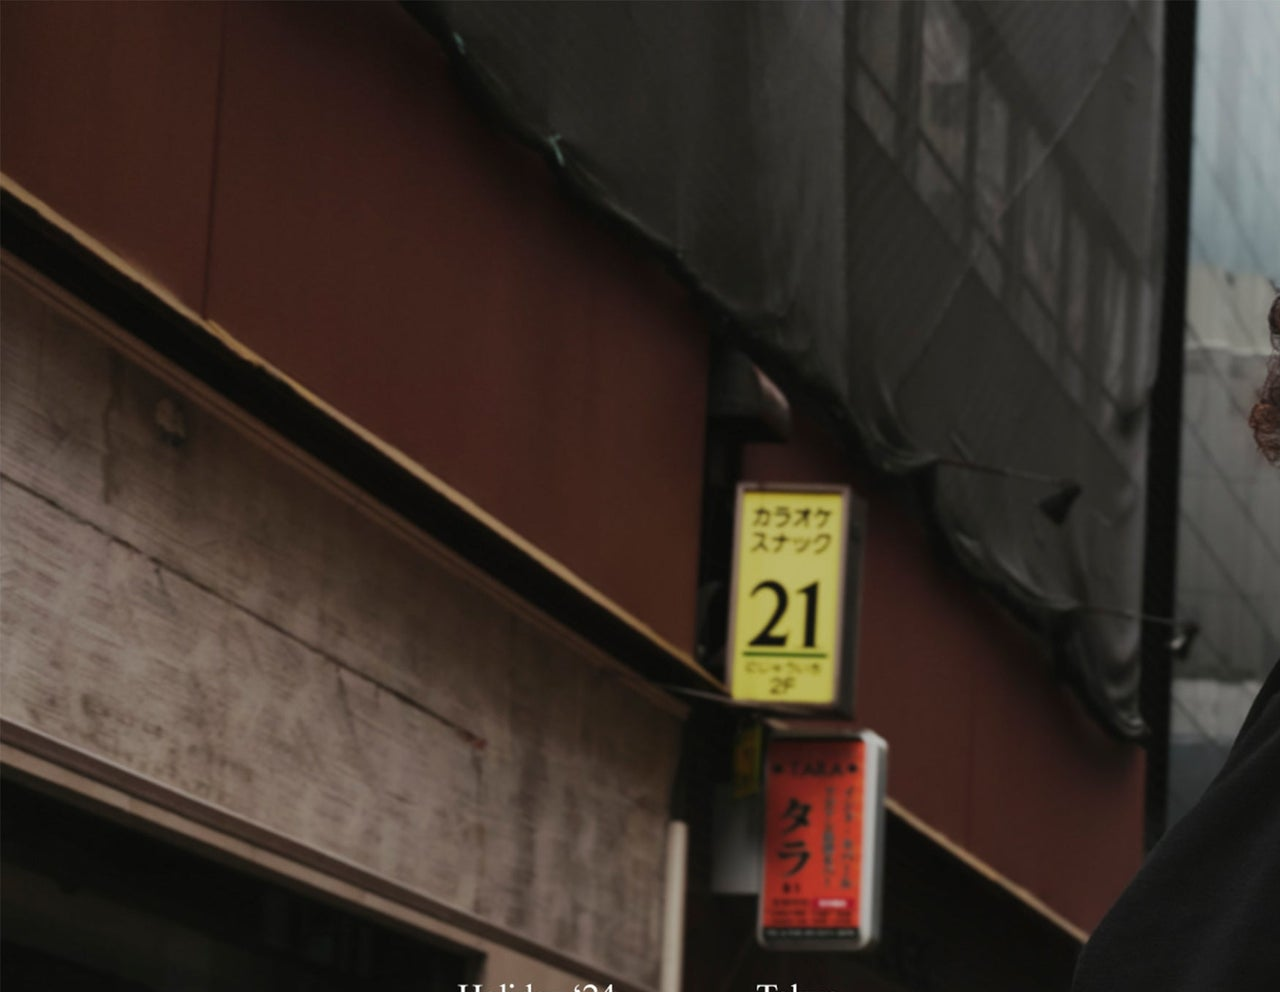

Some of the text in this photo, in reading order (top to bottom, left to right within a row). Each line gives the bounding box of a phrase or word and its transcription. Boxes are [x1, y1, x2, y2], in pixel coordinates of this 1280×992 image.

[752, 506, 833, 529] カラオケ
[750, 532, 833, 555] スナック
[748, 579, 820, 649] 21
